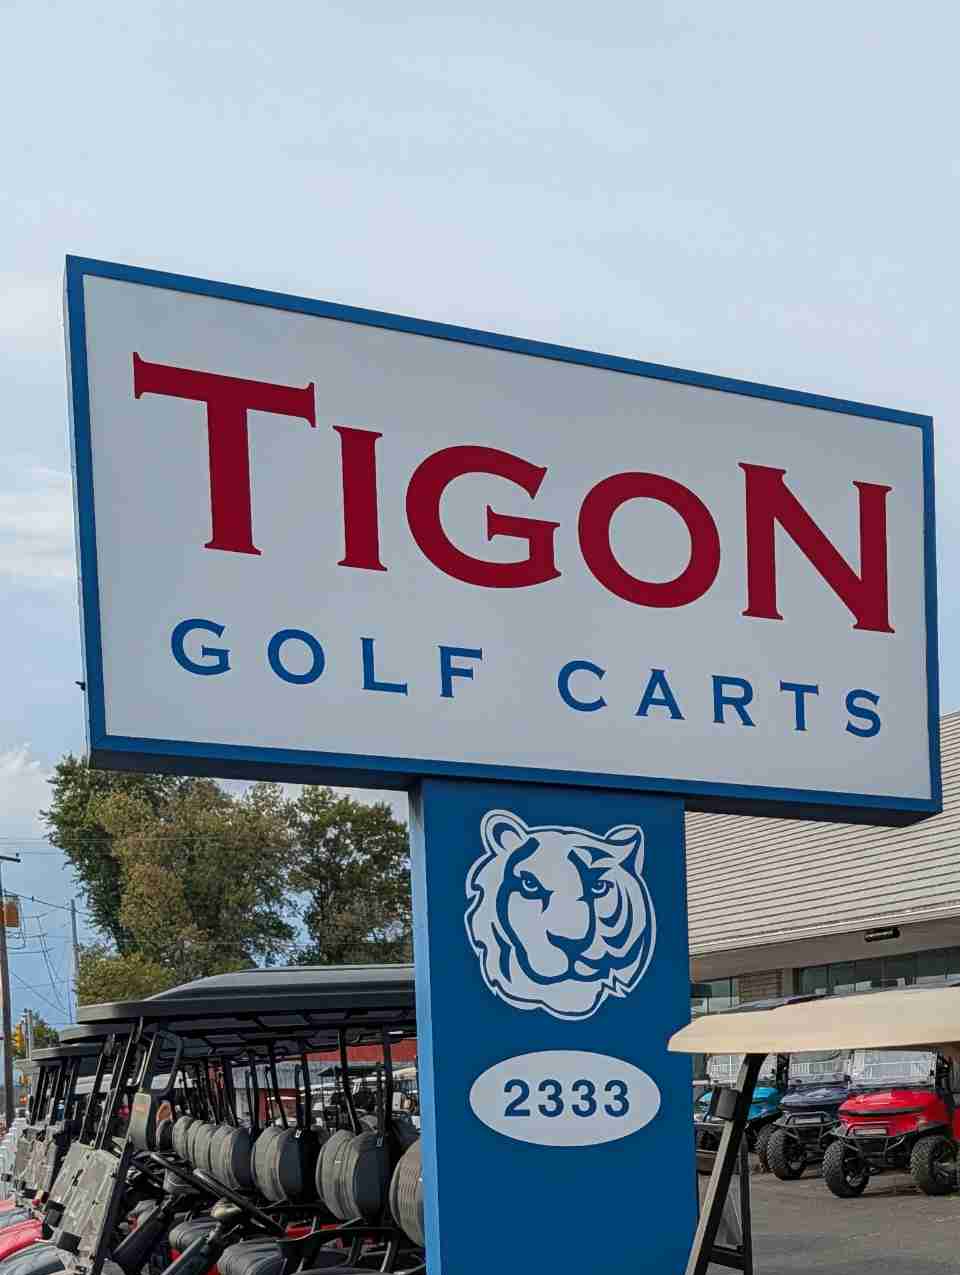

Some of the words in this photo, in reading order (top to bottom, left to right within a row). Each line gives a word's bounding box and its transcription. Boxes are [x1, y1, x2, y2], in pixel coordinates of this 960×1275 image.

[132, 353, 896, 634] TIGON
[170, 618, 483, 698] GOLF
[557, 659, 882, 739] CARTS
[503, 1078, 630, 1118] 2333
